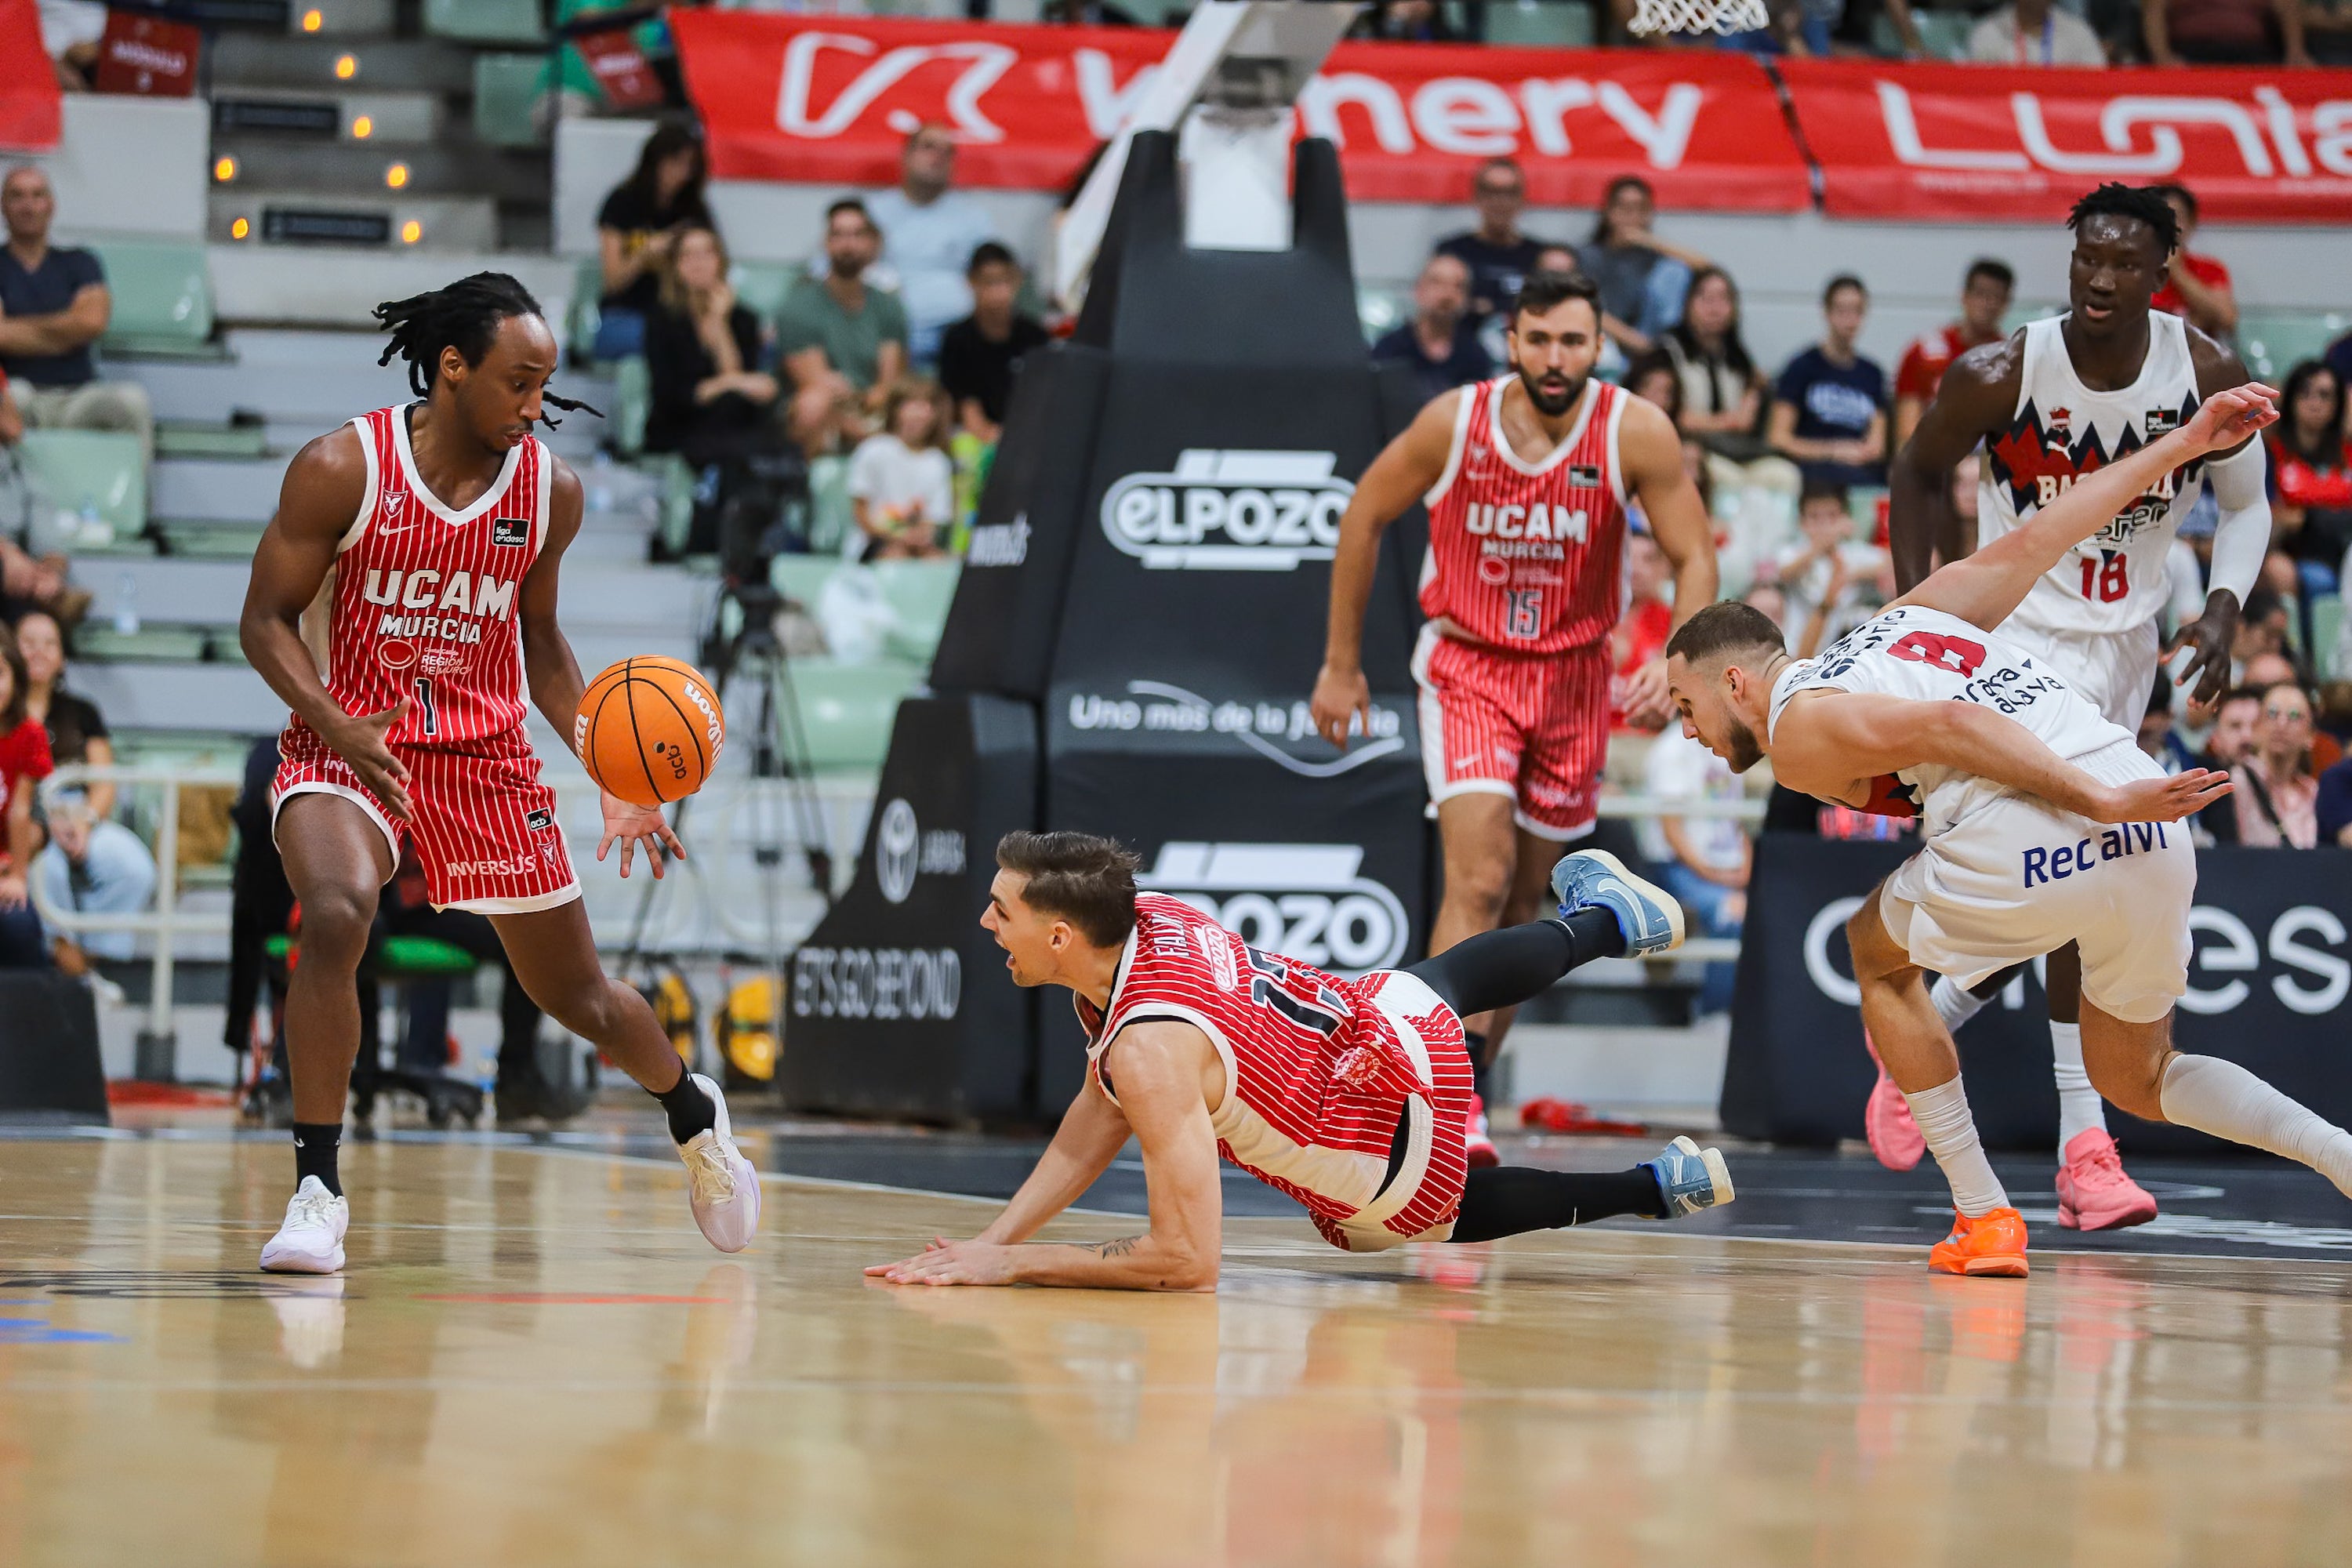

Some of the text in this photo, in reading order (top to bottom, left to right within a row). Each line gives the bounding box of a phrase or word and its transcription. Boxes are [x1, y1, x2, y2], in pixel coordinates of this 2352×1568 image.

[1466, 503, 1588, 544] UCAM
[1481, 539, 1565, 561] MURCIA
[364, 568, 516, 622] UCAM
[2079, 553, 2129, 603] 18
[379, 614, 481, 644] MURCIA
[1505, 589, 1542, 640] 15
[414, 677, 437, 736] 1
[667, 745, 687, 779] acb
[530, 818, 546, 829] acb
[445, 853, 536, 877] INVERSUS
